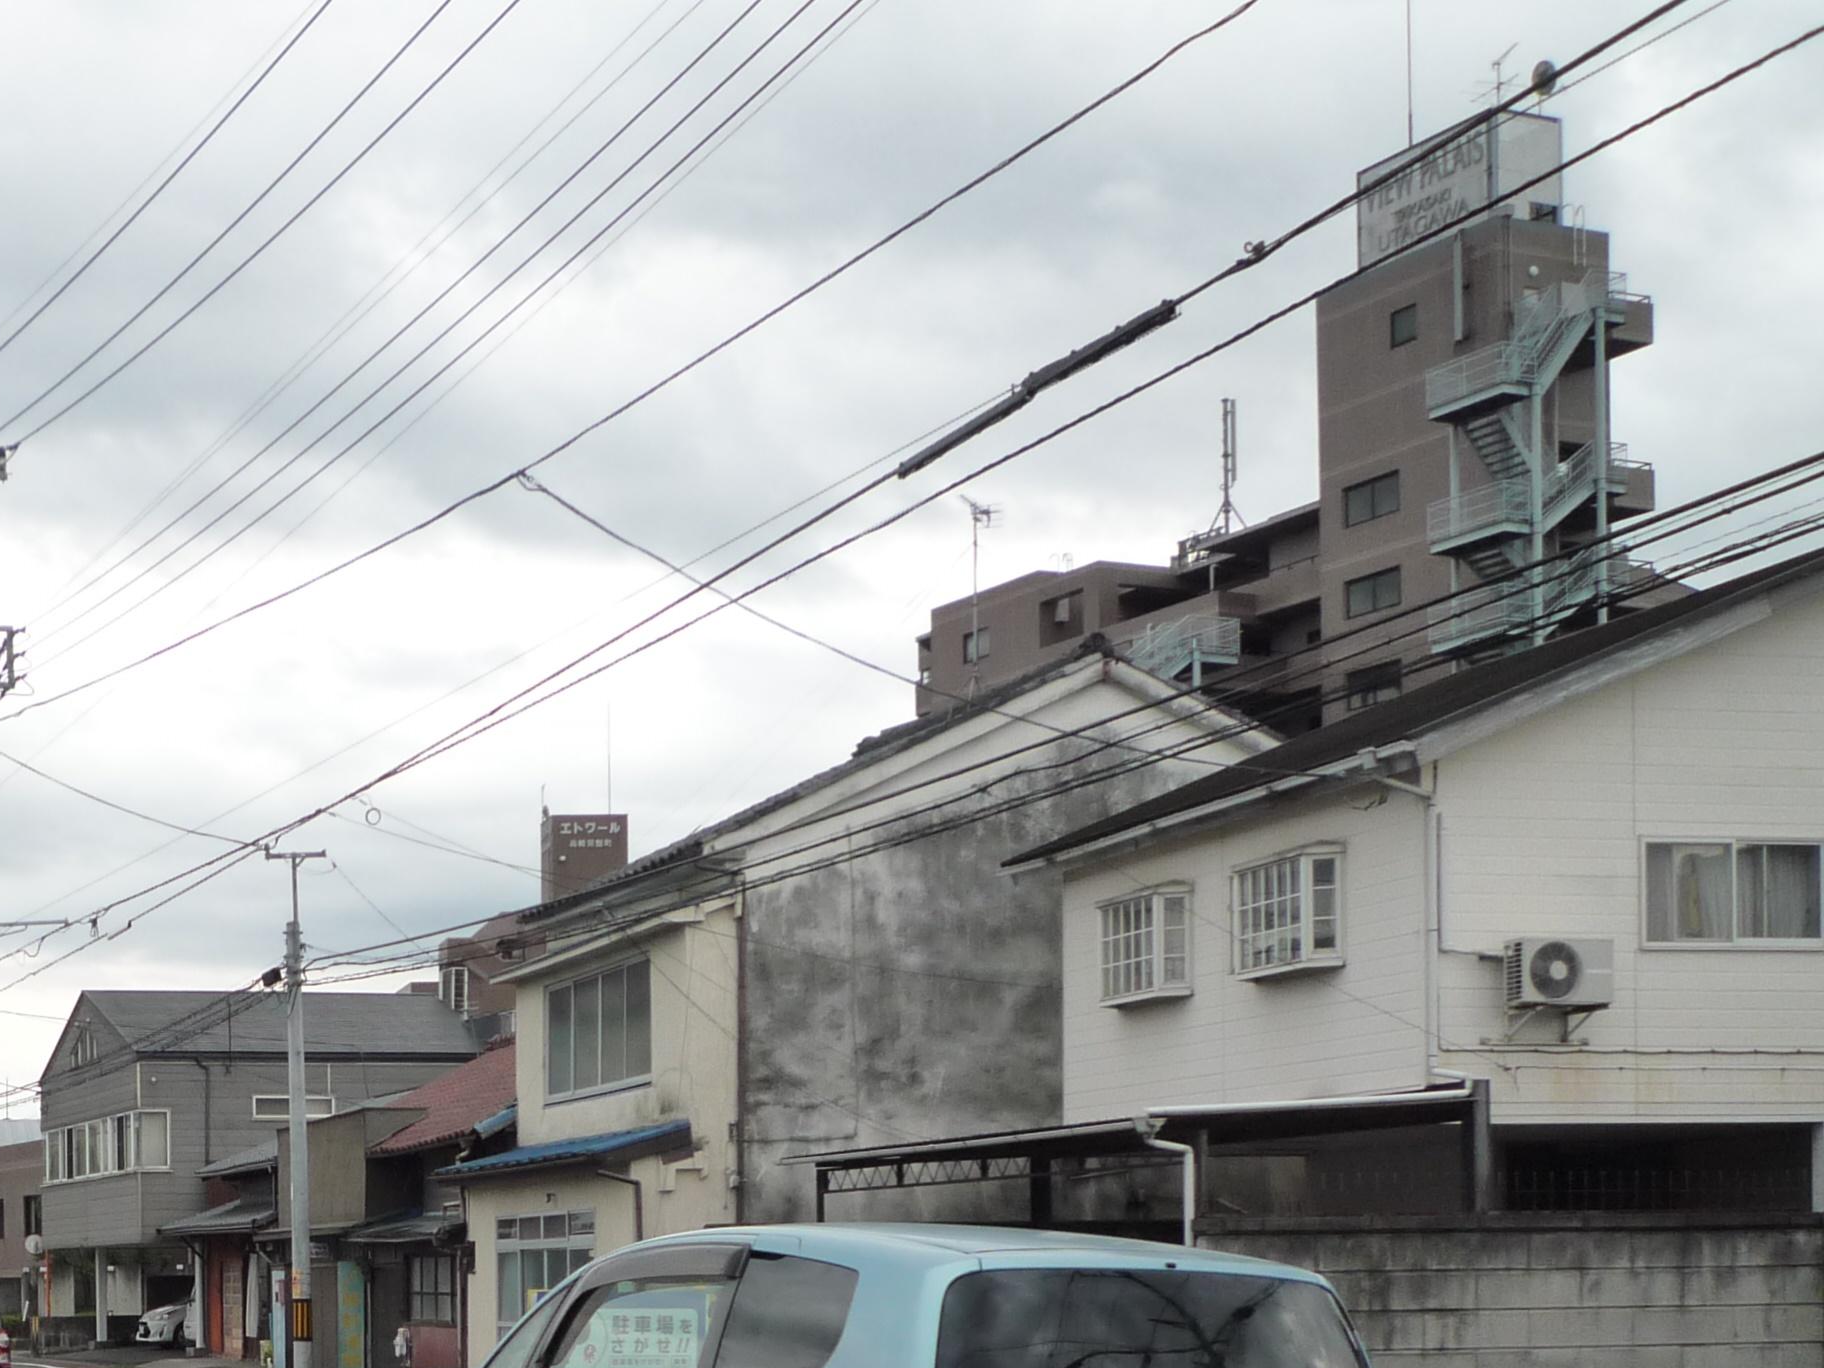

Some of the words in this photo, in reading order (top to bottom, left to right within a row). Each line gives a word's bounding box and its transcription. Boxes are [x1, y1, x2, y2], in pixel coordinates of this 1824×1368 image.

[1364, 168, 1414, 213] VIEW
[1378, 198, 1472, 252] UTAGAWA
[559, 822, 621, 834] エトワール
[612, 1314, 693, 1335] 駐車場を
